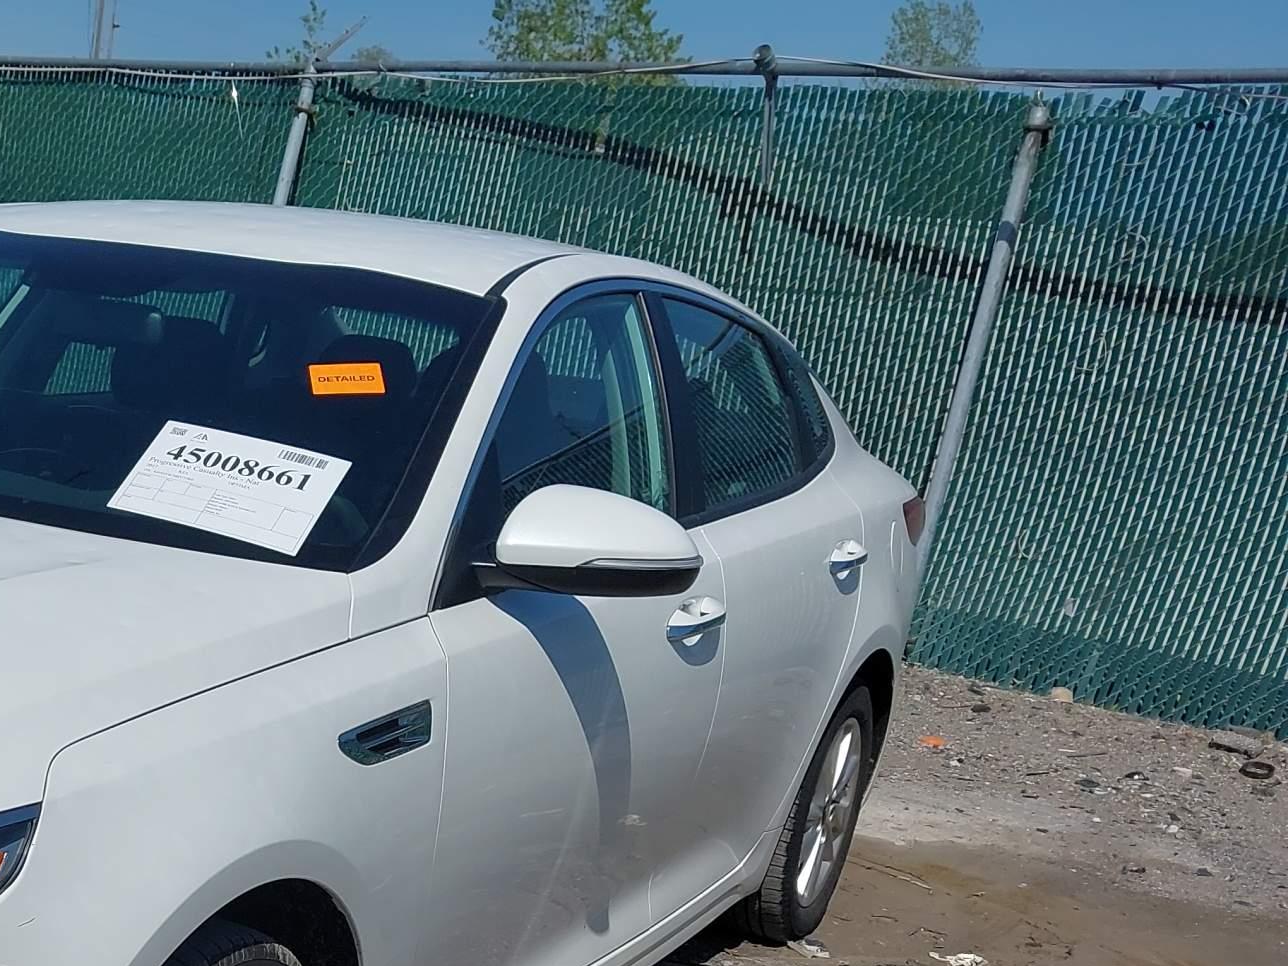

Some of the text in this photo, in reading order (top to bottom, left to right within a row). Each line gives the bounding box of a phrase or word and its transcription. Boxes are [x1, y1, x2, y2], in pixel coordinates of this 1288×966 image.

[317, 374, 376, 383] DETAILED
[148, 456, 193, 470] Progressive
[193, 465, 226, 479] Casualty
[226, 473, 239, 481] Ins
[166, 444, 312, 492] 45008661
